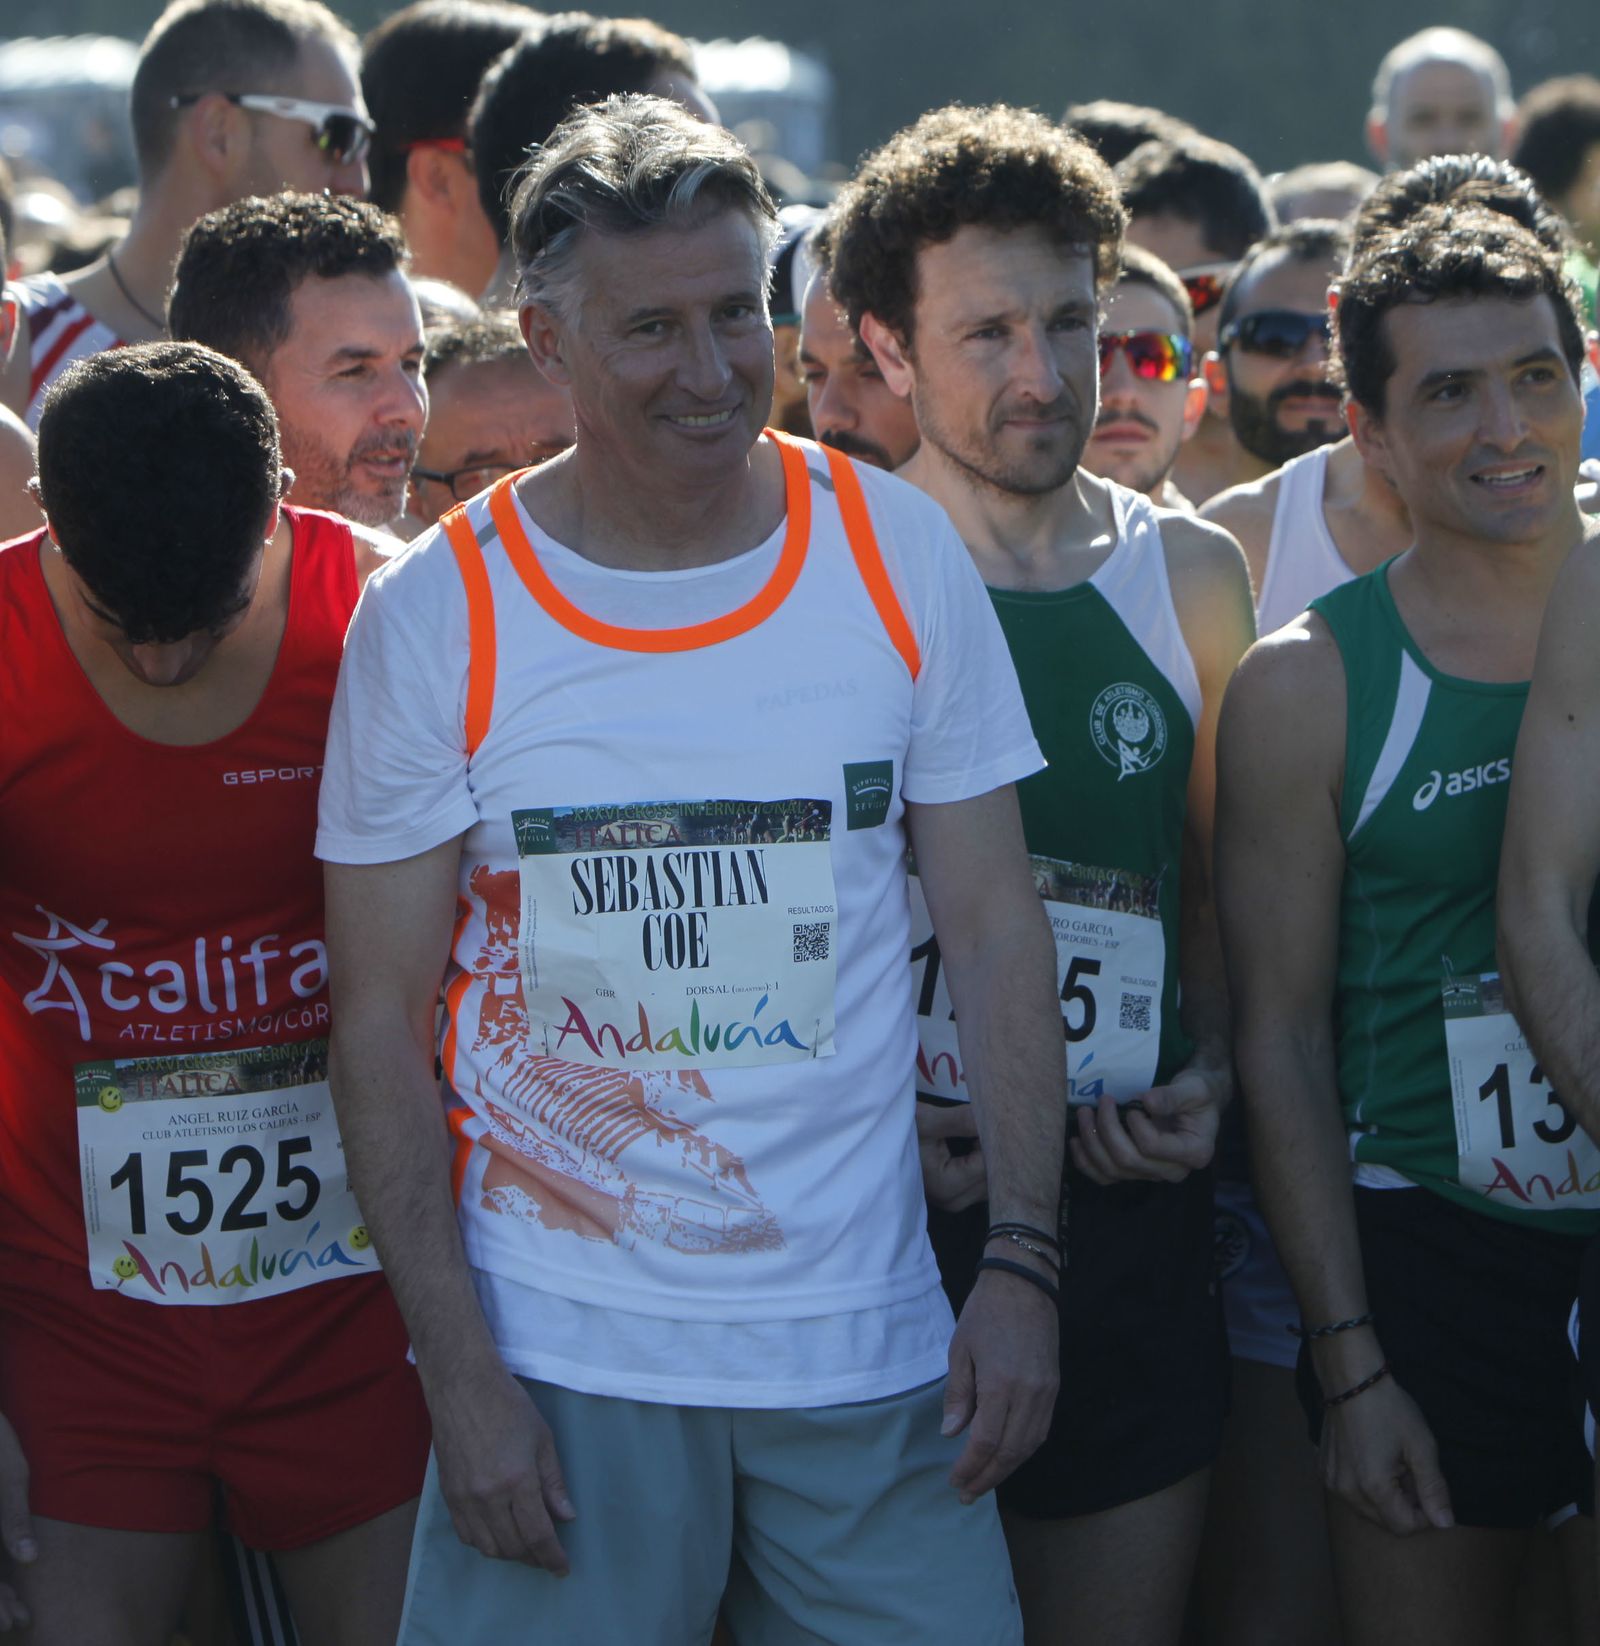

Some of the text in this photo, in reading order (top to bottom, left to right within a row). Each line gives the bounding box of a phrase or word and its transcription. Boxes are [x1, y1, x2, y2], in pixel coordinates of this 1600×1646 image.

[1445, 758, 1511, 796] asics
[624, 804, 675, 820] CROSS
[679, 799, 809, 818] INTERNACIONAL
[574, 820, 683, 849] ITALICA
[570, 848, 770, 917] SEBASTIAN
[787, 905, 835, 917] RESULTADOS
[642, 911, 711, 972] COE
[595, 987, 616, 999] GBR
[686, 984, 730, 997] DORSAL
[552, 993, 814, 1059] Andalucía
[184, 1053, 235, 1069] CROSS
[136, 1071, 243, 1099] ITALICA
[142, 1128, 173, 1142] CLUB
[174, 1124, 236, 1140] ATLETISMO
[236, 1122, 258, 1135] LOS
[259, 1116, 299, 1132] CALIFAS
[305, 1111, 323, 1123] ESP
[168, 1102, 299, 1127] ANGEL RUIZ GARCÍA
[110, 1135, 322, 1237] 1525
